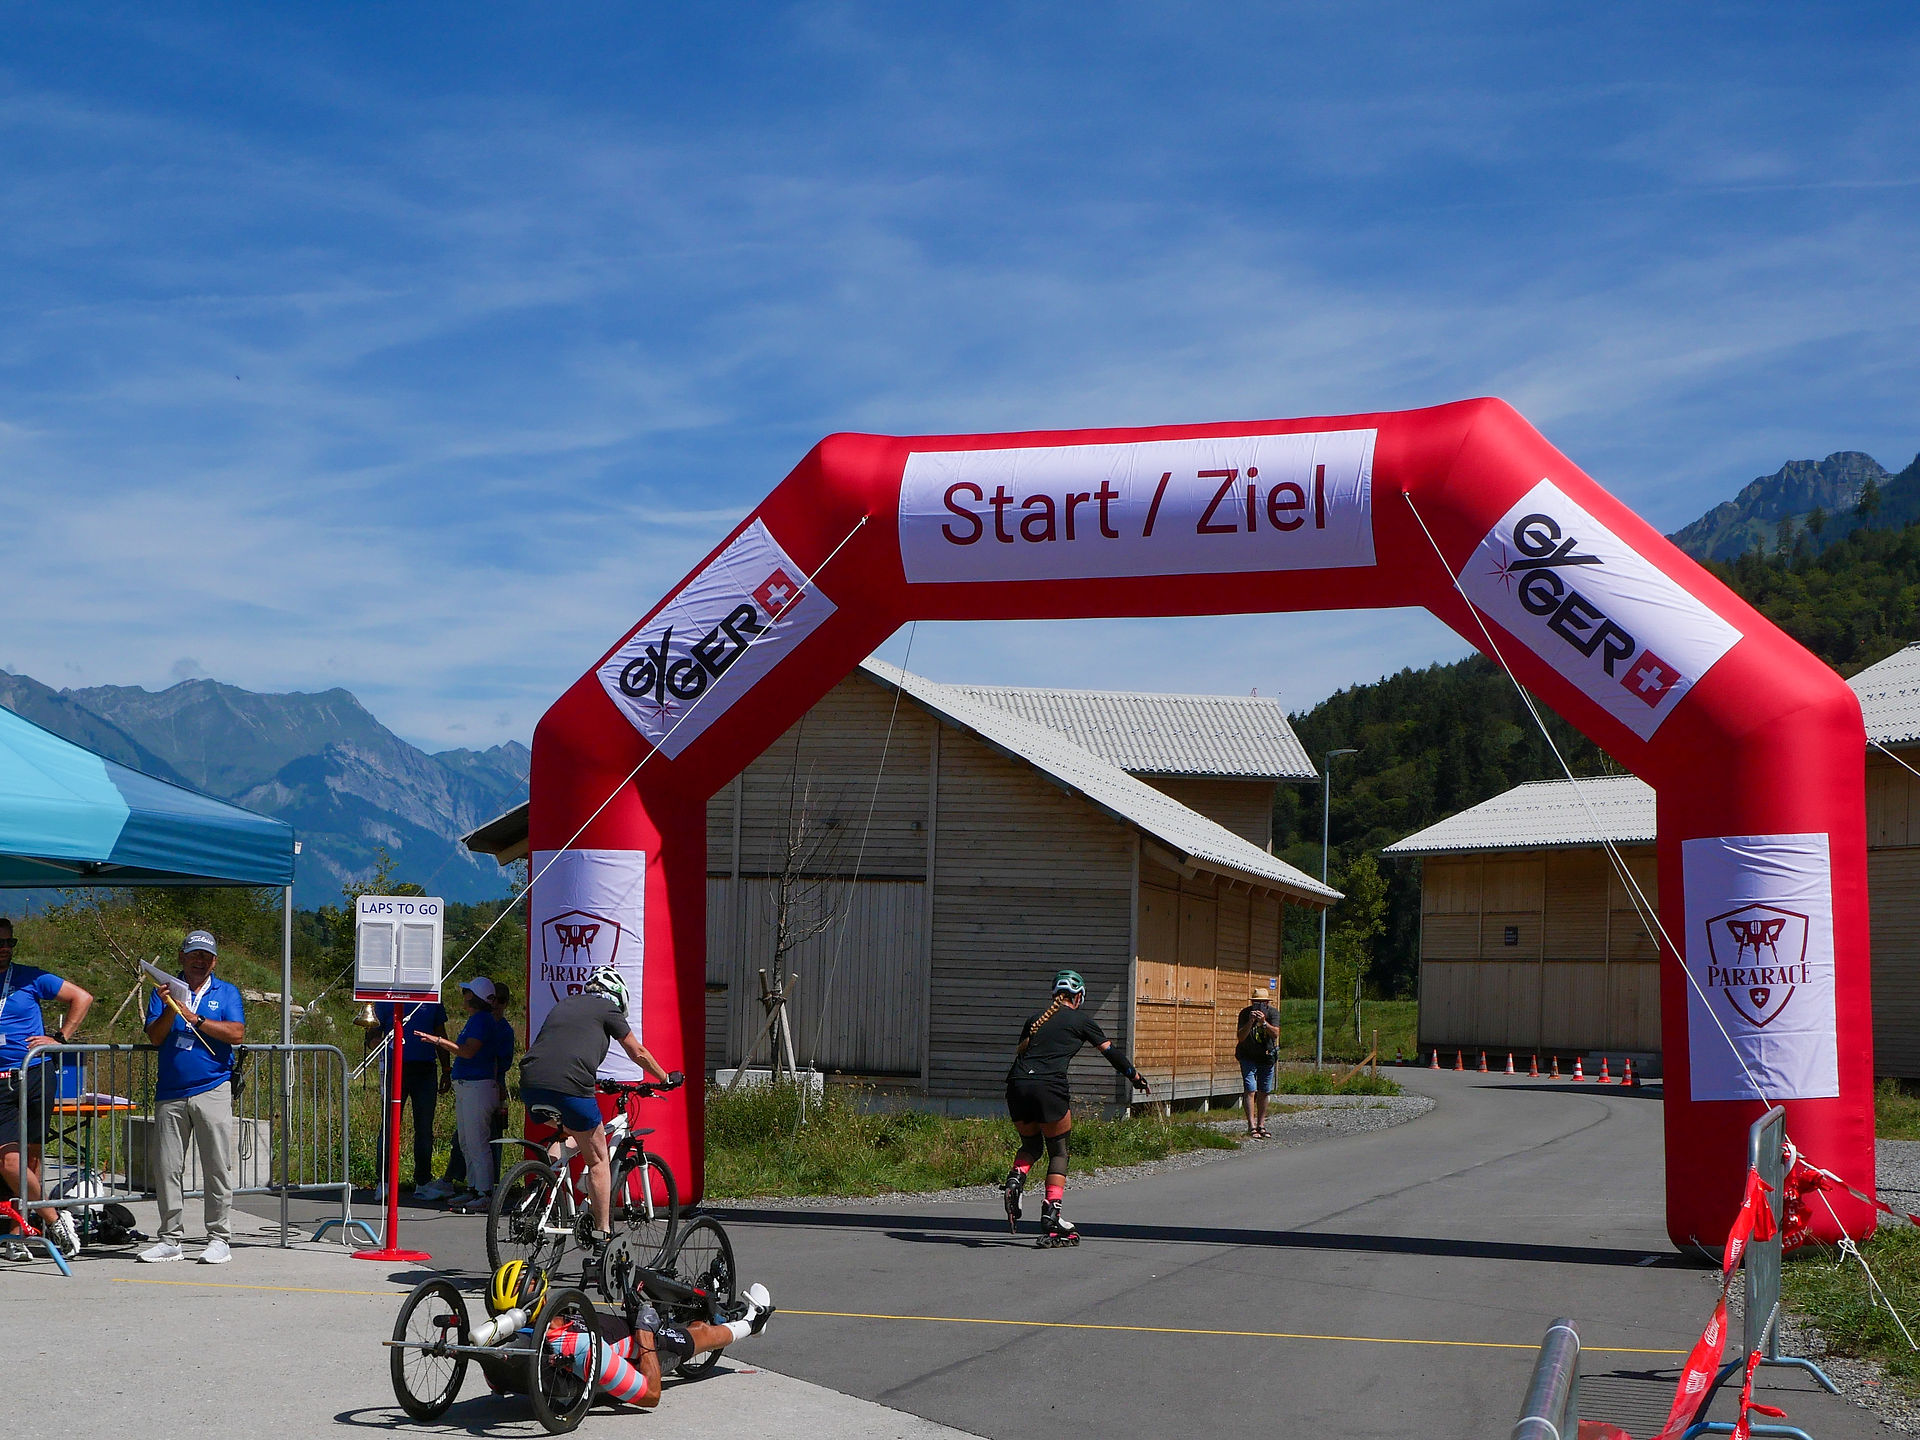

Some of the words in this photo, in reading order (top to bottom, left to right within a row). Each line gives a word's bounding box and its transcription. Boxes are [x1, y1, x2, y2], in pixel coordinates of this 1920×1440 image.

[942, 481, 1119, 546] Start
[1141, 473, 1172, 538] /
[1194, 464, 1326, 537] Ziel
[1513, 514, 1636, 679] GYGER
[619, 603, 772, 708] GYGER
[361, 902, 393, 914] LAPS
[397, 903, 415, 915] TO
[419, 904, 438, 915] GO
[1707, 962, 1812, 987] PARARACE
